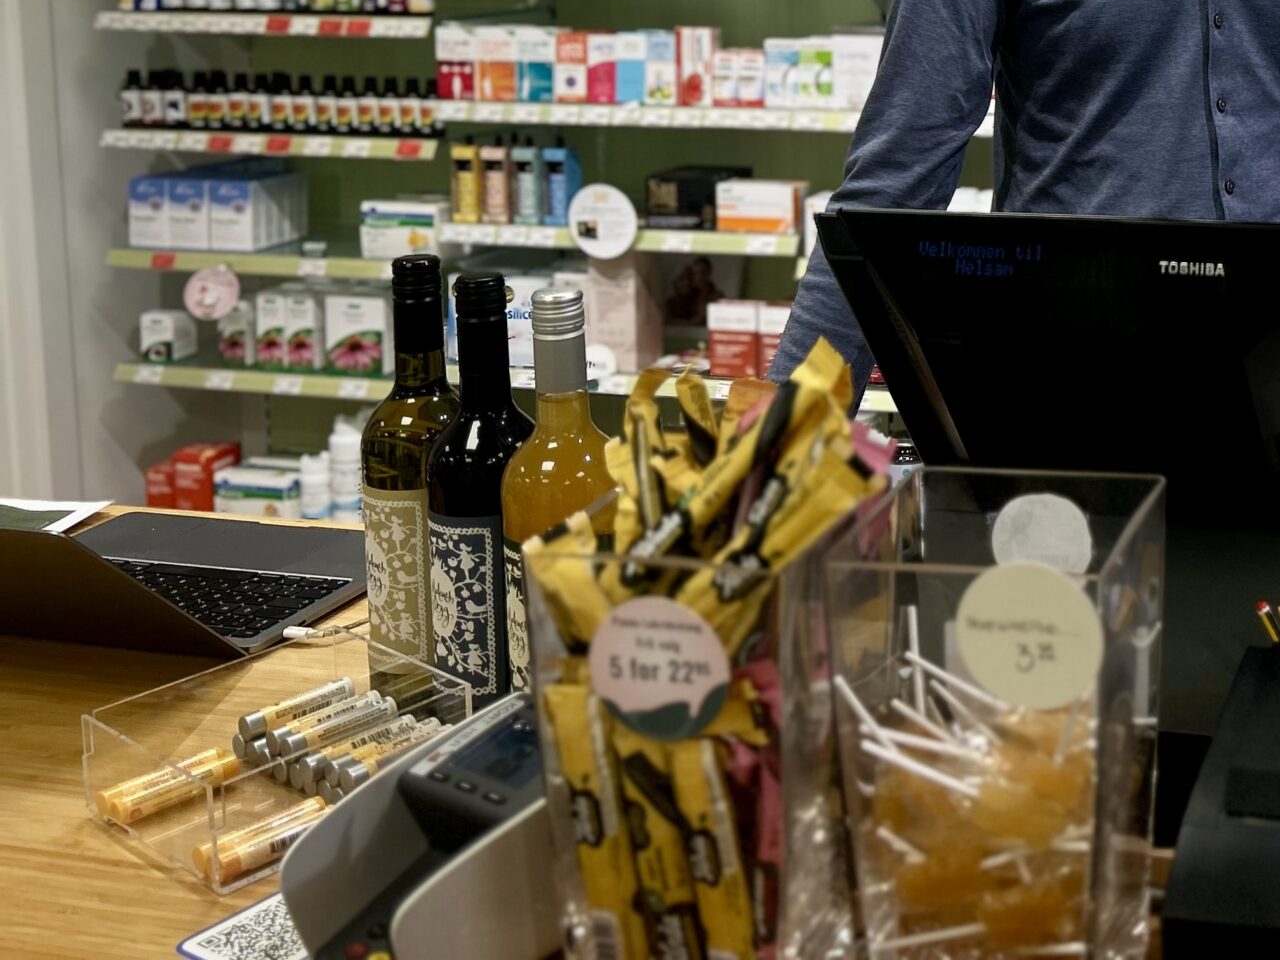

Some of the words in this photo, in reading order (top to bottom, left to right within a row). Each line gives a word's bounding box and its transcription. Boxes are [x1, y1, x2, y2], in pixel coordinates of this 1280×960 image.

[1016, 244, 1042, 260] til
[955, 259, 1014, 276] Helsam
[1159, 260, 1225, 277] TOSHIBA
[609, 655, 622, 679] 5
[629, 658, 660, 680] for
